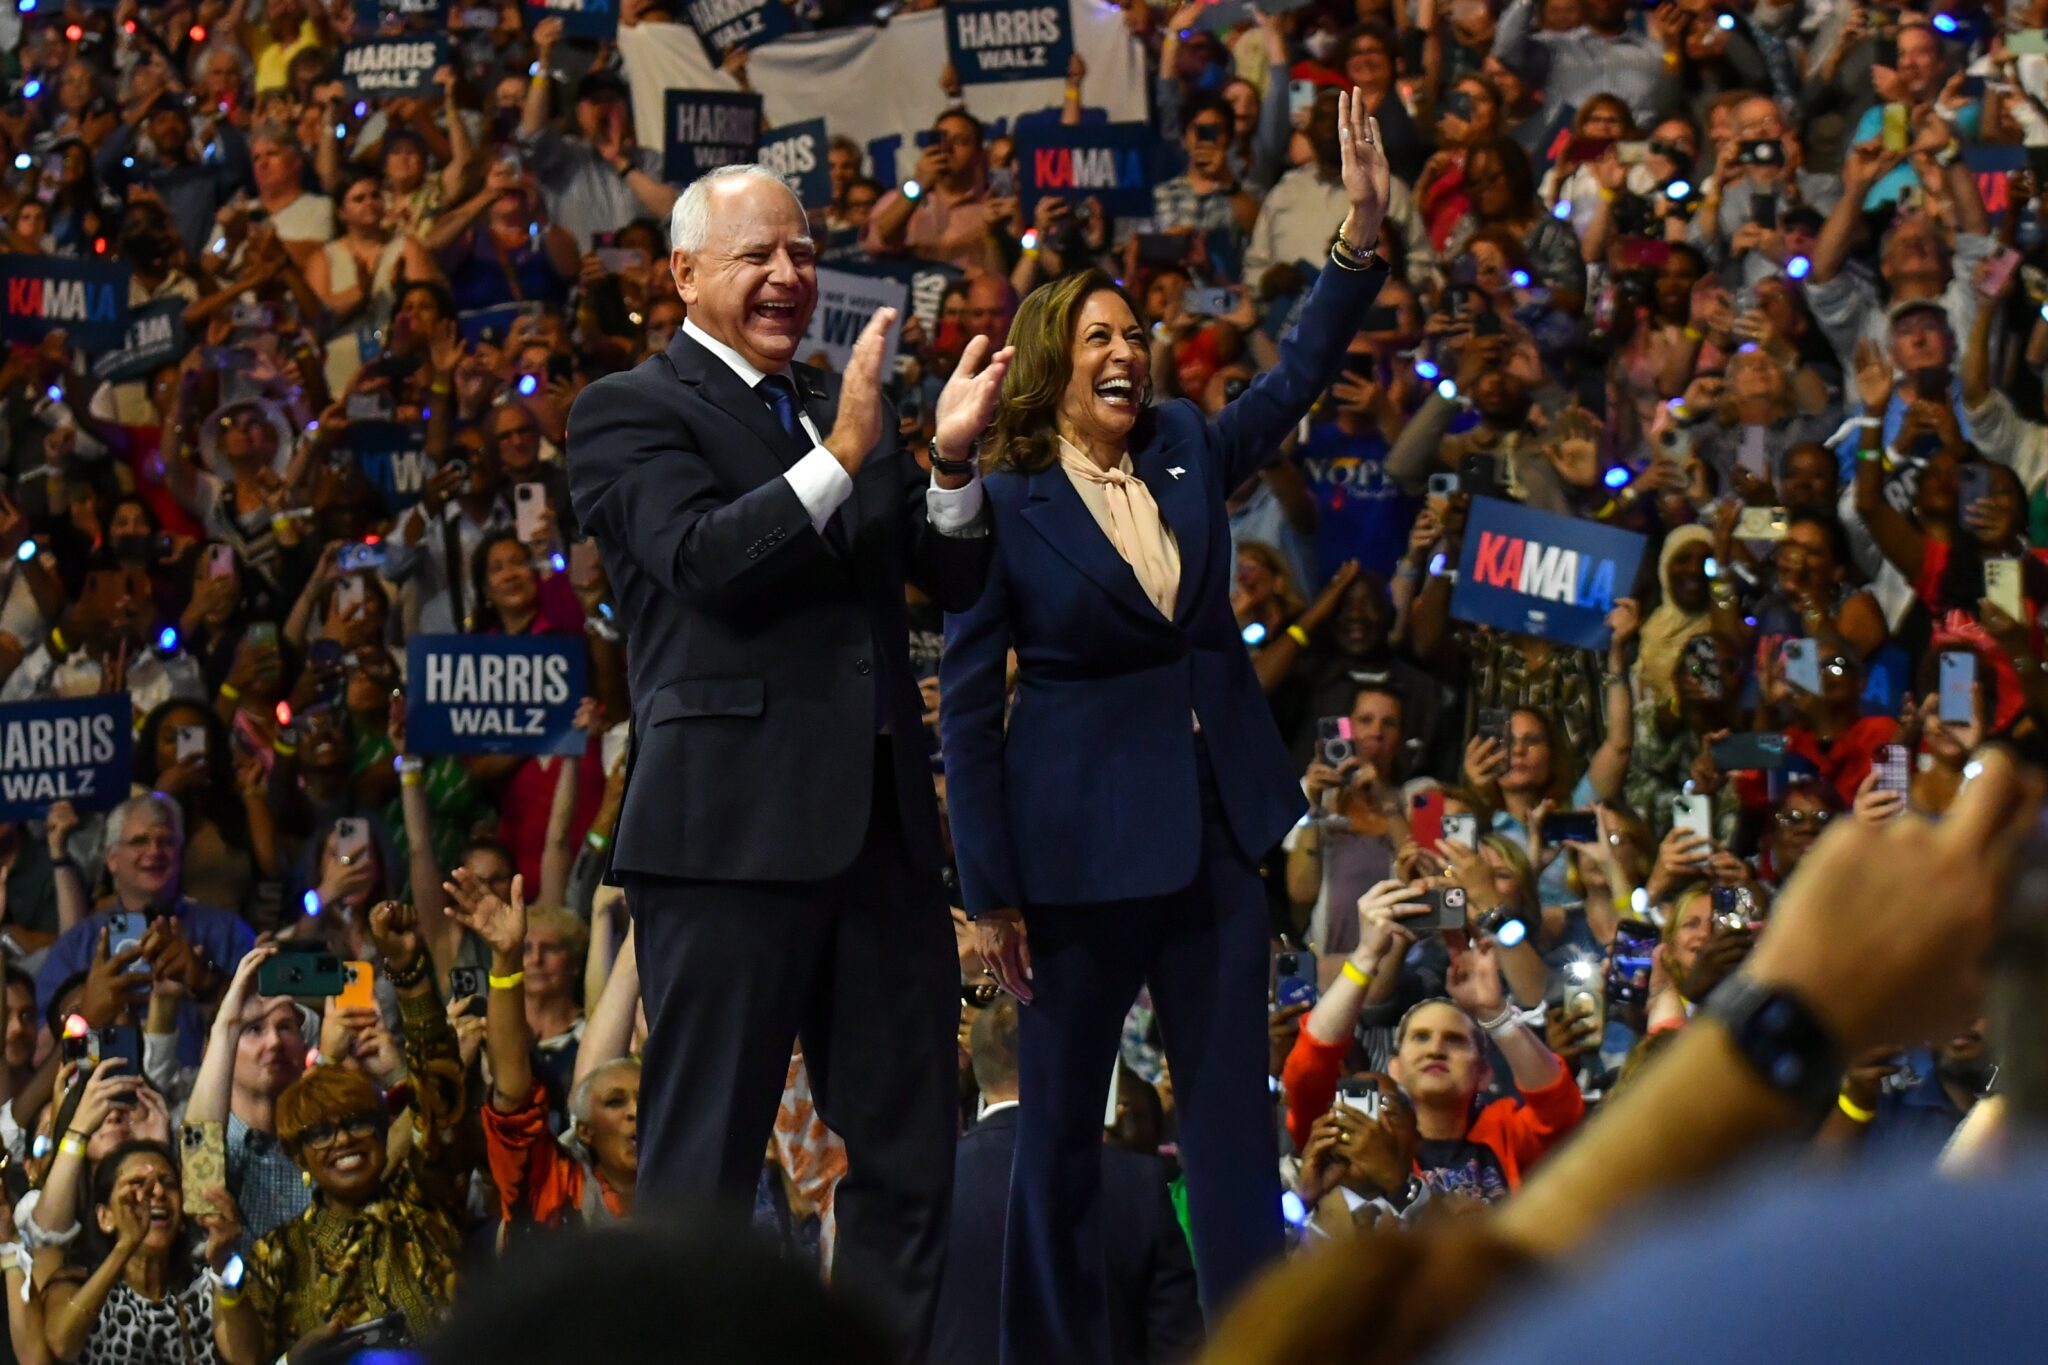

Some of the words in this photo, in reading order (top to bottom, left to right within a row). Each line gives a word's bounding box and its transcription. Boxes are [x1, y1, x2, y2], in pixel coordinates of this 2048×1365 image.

[958, 7, 1060, 49] HARRIS
[343, 42, 437, 75] HARRIS
[977, 47, 1048, 70] WALZ
[357, 70, 420, 90] WALZ
[1034, 148, 1143, 188] KAMALA
[8, 277, 117, 321] KAMALA
[1473, 531, 1616, 612] KAMALA
[425, 653, 569, 704] HARRIS
[0, 713, 115, 770] ARRIS
[449, 708, 546, 735] WALZ
[1, 768, 96, 802] WALZ
